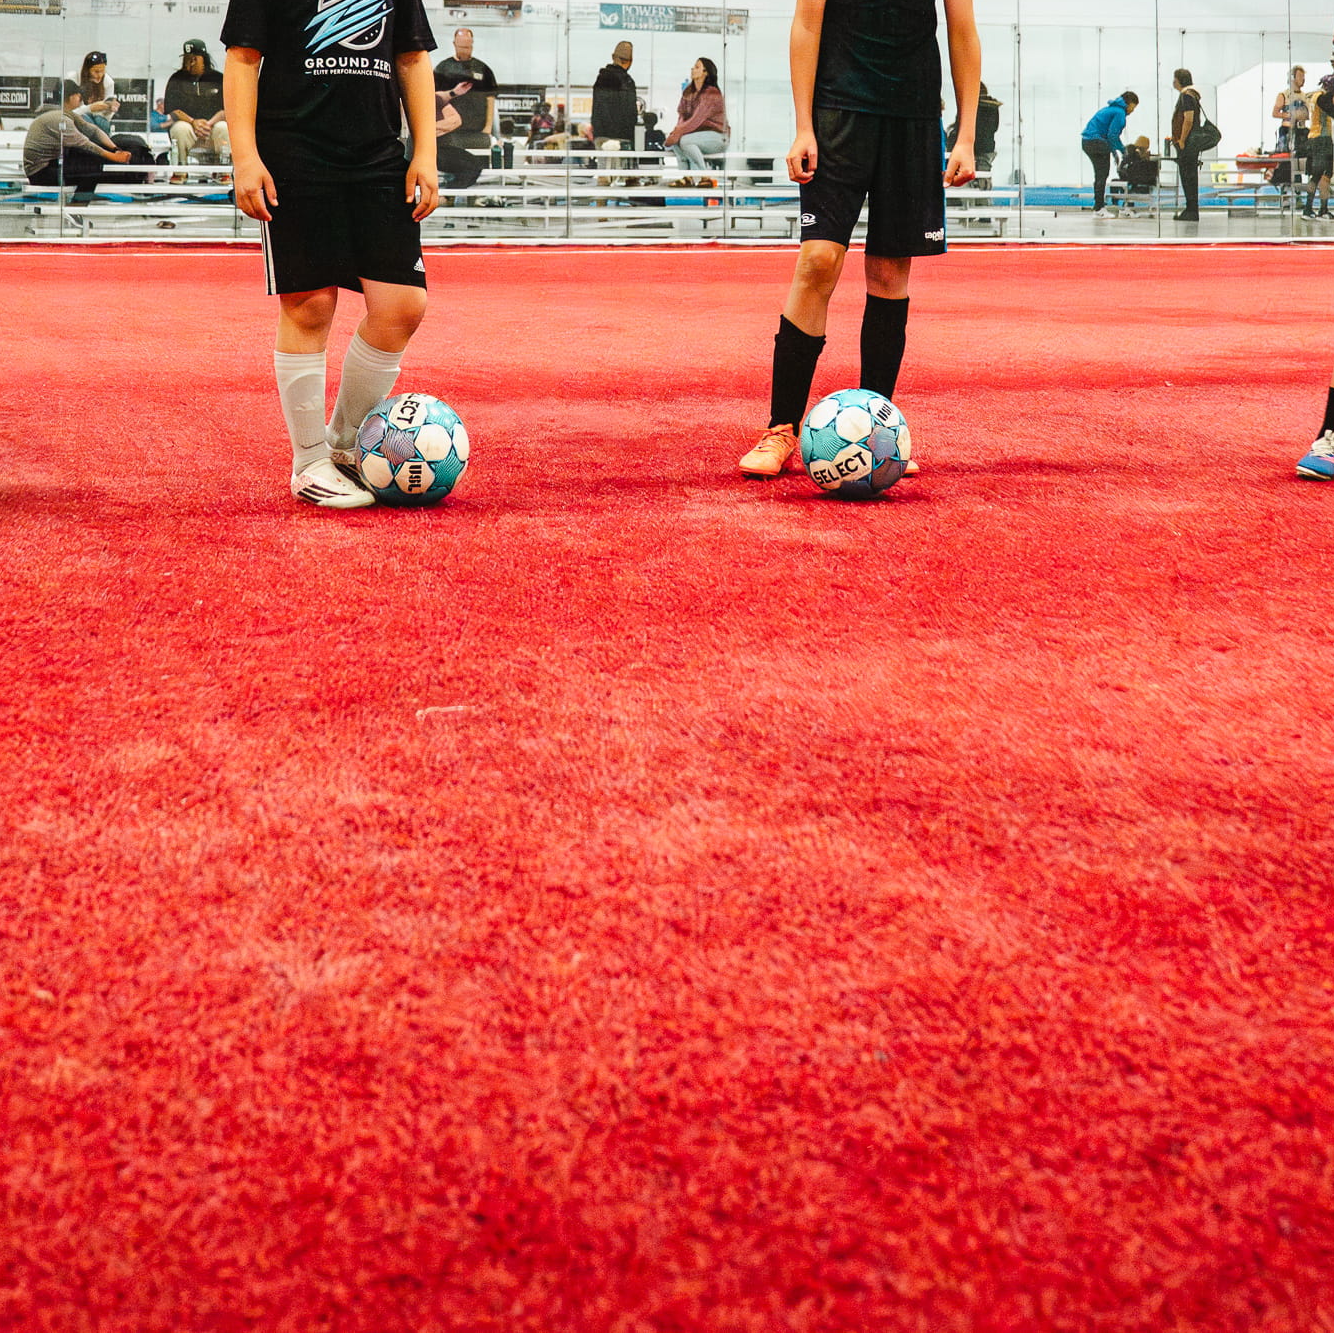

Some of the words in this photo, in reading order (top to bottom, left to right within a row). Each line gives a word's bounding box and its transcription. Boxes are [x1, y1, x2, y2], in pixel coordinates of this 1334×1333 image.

[622, 5, 674, 19] POWERS
[304, 56, 370, 69] GROUND
[329, 68, 373, 77] PERFORMANCE
[813, 451, 868, 485] SELECT
[407, 463, 423, 493] USL
